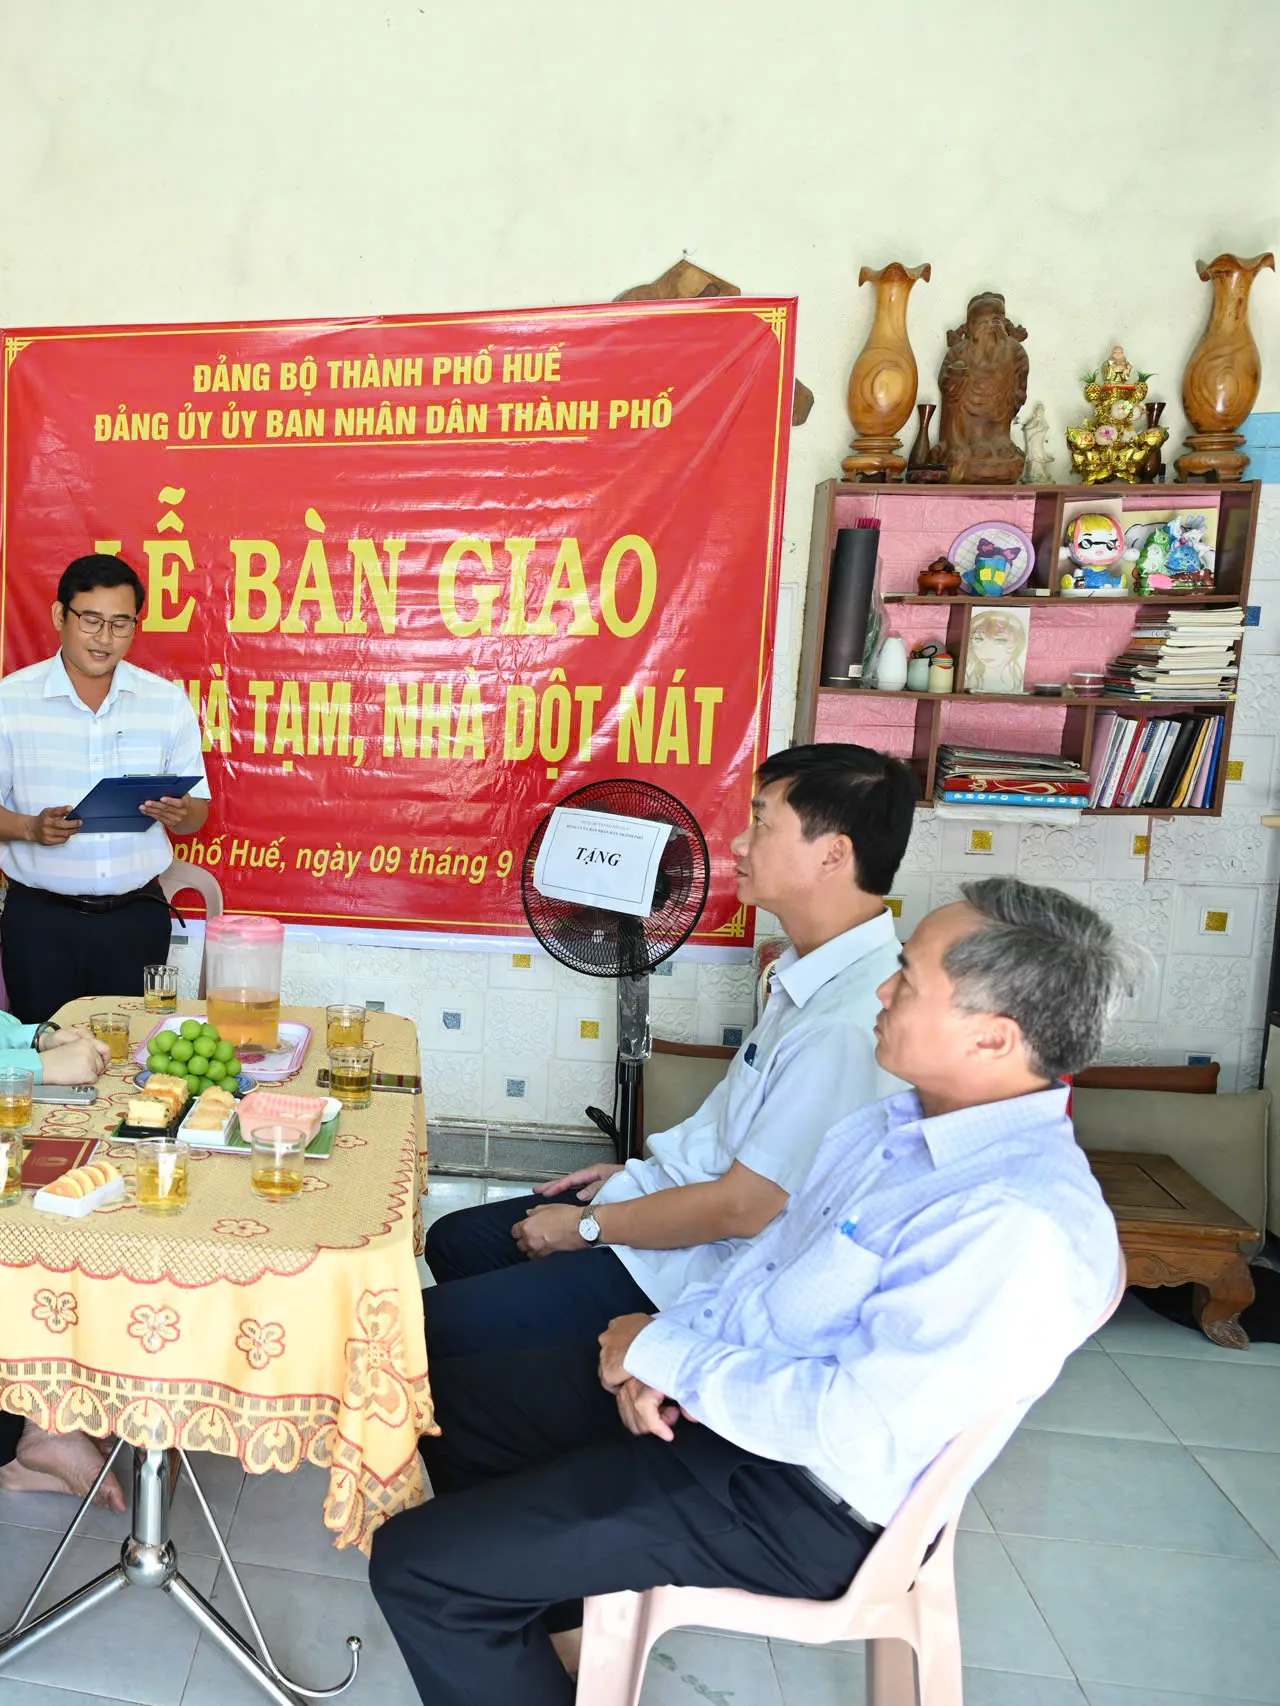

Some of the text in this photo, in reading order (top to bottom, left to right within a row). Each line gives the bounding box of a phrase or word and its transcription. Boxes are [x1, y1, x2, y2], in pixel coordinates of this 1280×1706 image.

[194, 341, 566, 396] ĐẢNG BỘ THÀNH PHỐ HUẾ
[94, 386, 676, 442] ĐẢNG ỦY ỦY BAN NHÂN DÂN THÀNH PHỐ
[94, 486, 658, 638] Ễ BÀN GIAO
[249, 680, 365, 772] TẠM,
[382, 666, 486, 760] NHÀ
[504, 667, 603, 780] DỘT
[616, 668, 724, 765] NÁT
[173, 834, 227, 865] phố
[229, 836, 286, 873] Huế,
[295, 842, 362, 879] ngày
[369, 845, 402, 874] 09
[409, 846, 488, 885] tháng
[496, 849, 513, 878] 9
[576, 847, 622, 866] TẶNG
